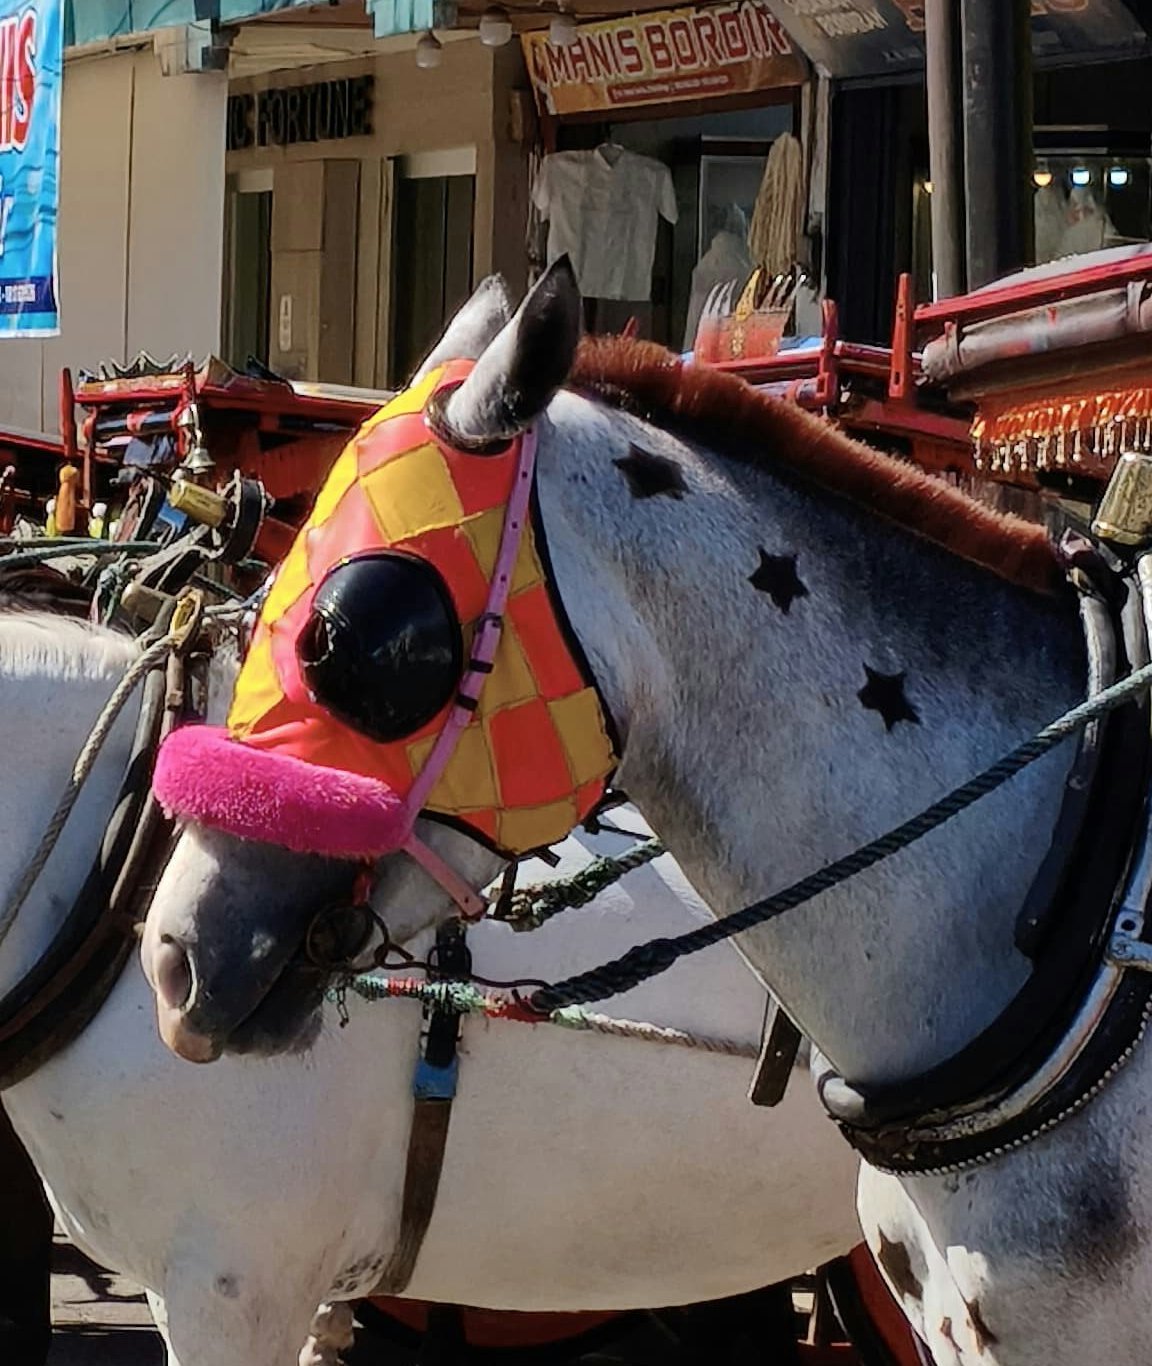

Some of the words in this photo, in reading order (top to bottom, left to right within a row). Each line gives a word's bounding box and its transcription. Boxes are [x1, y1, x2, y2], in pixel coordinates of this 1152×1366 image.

[546, 28, 644, 85] MANIS
[644, 1, 791, 72] BORDIR
[255, 73, 375, 148] FORTUNE
